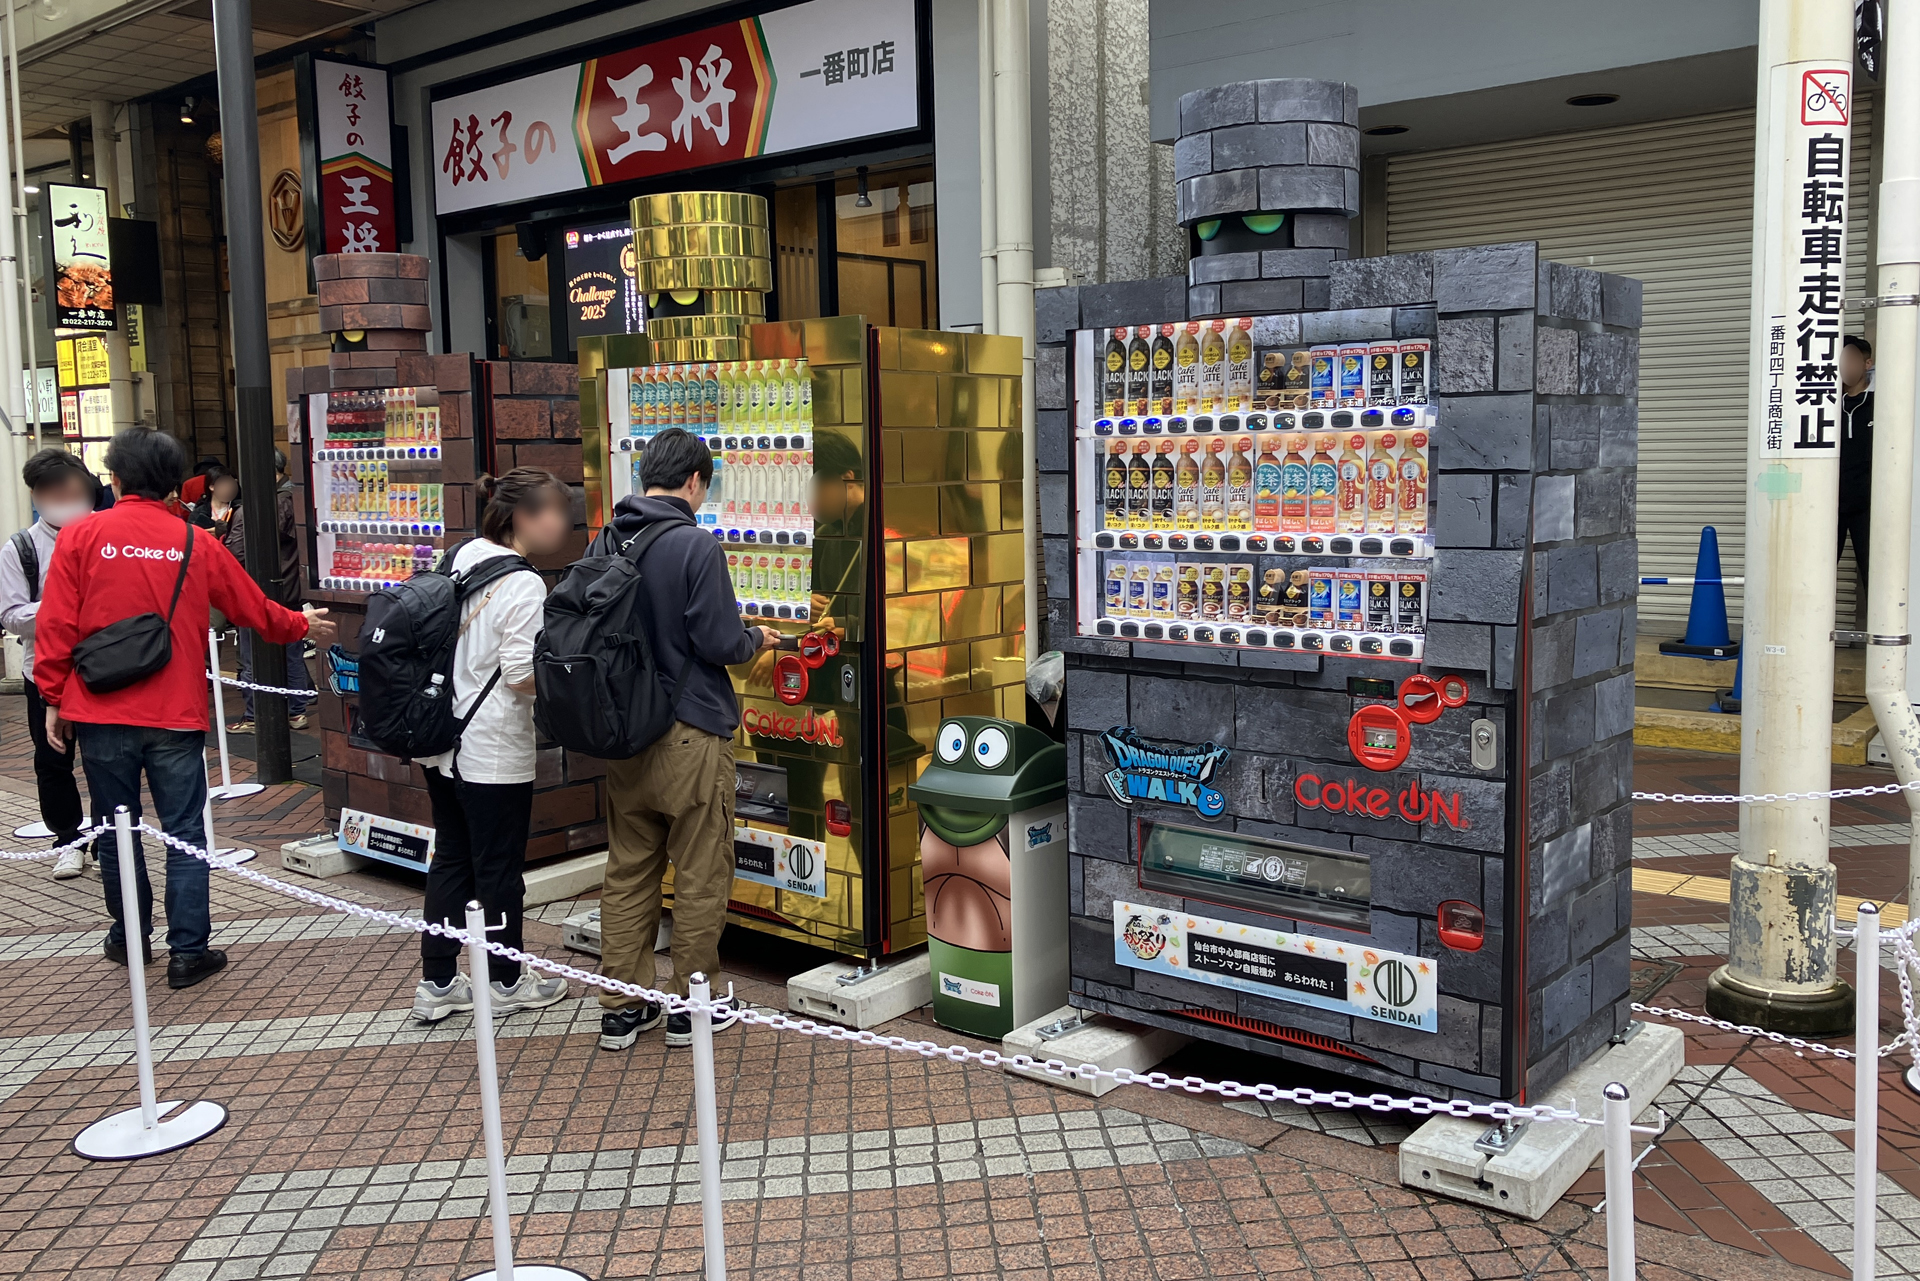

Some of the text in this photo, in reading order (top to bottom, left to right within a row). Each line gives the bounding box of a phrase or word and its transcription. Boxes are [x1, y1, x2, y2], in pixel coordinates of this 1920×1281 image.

[442, 40, 895, 187] 餃子の 王将 一番町店
[339, 73, 381, 253] 餃子の 王将
[570, 285, 616, 305] Challenge
[1793, 132, 1846, 450] 自転車走行禁止
[580, 304, 606, 320] 2025
[69, 318, 113, 327] 022-217-3270
[1178, 375, 1195, 383] LATTE
[1203, 373, 1220, 382] LATTE
[1229, 371, 1248, 380] LATTE
[1371, 373, 1392, 382] BLACK
[1402, 371, 1423, 380] BLACK
[1766, 313, 1787, 450] 一番町四丁目商店街
[1257, 473, 1279, 487] 麦茶
[1283, 473, 1305, 487] 麦茶
[1311, 472, 1334, 487] 麦茶
[1178, 494, 1194, 502] LATTE
[1203, 494, 1220, 502] LATTE
[1230, 494, 1246, 502] LATTE
[122, 545, 164, 560] Coke
[1369, 600, 1389, 608] BLACK
[1399, 600, 1420, 610] BLACK
[1765, 645, 1786, 654] W3-6
[743, 708, 797, 739] Coke
[1105, 733, 1224, 782] DRAGON QUEST
[1137, 768, 1188, 780] ドラゴンクエストウォーク
[1126, 774, 1198, 806] WALK
[1295, 773, 1390, 817] Coke
[787, 879, 817, 893] SENDAI
[1193, 941, 1276, 966] 仙台市中心部商店街に
[1194, 954, 1335, 991] ストーンマン自販機が あらわれた！
[1371, 1005, 1421, 1026] SENDAI
